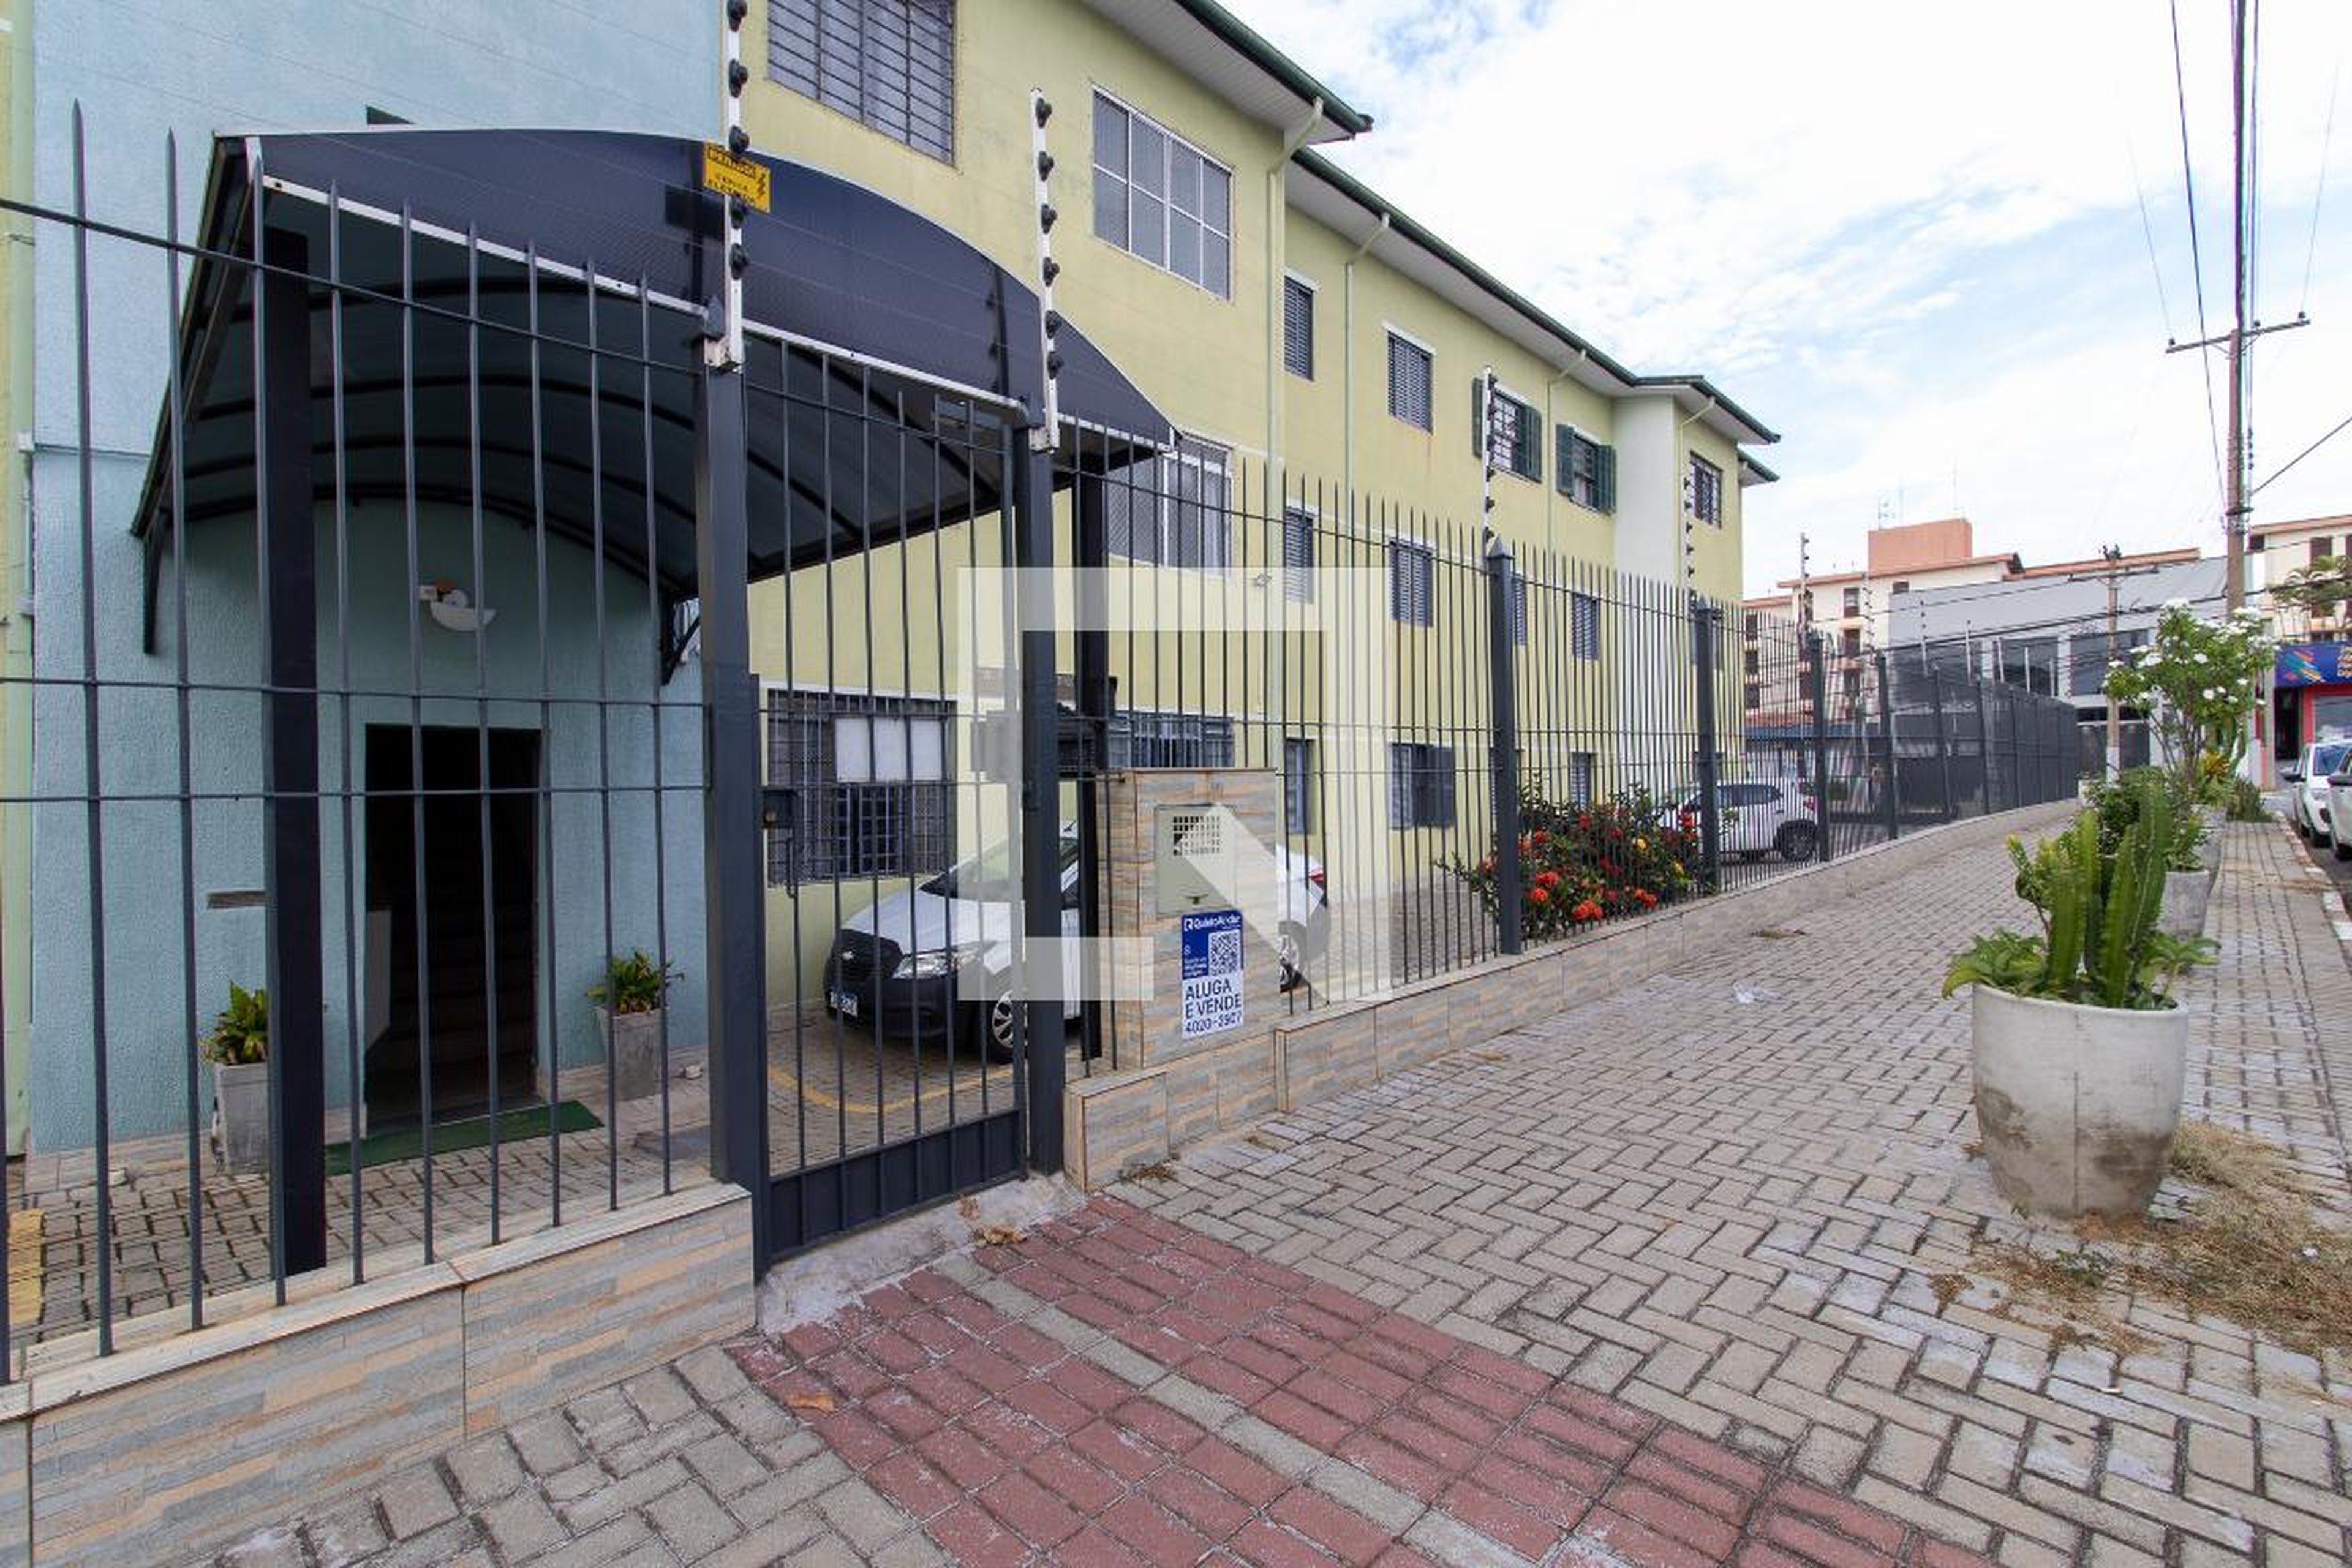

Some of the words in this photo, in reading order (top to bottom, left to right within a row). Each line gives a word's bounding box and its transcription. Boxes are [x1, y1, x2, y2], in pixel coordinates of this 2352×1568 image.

[1185, 978, 1232, 1001] ALUGA
[1186, 1002, 1194, 1019] E
[1196, 994, 1242, 1016] VENDE
